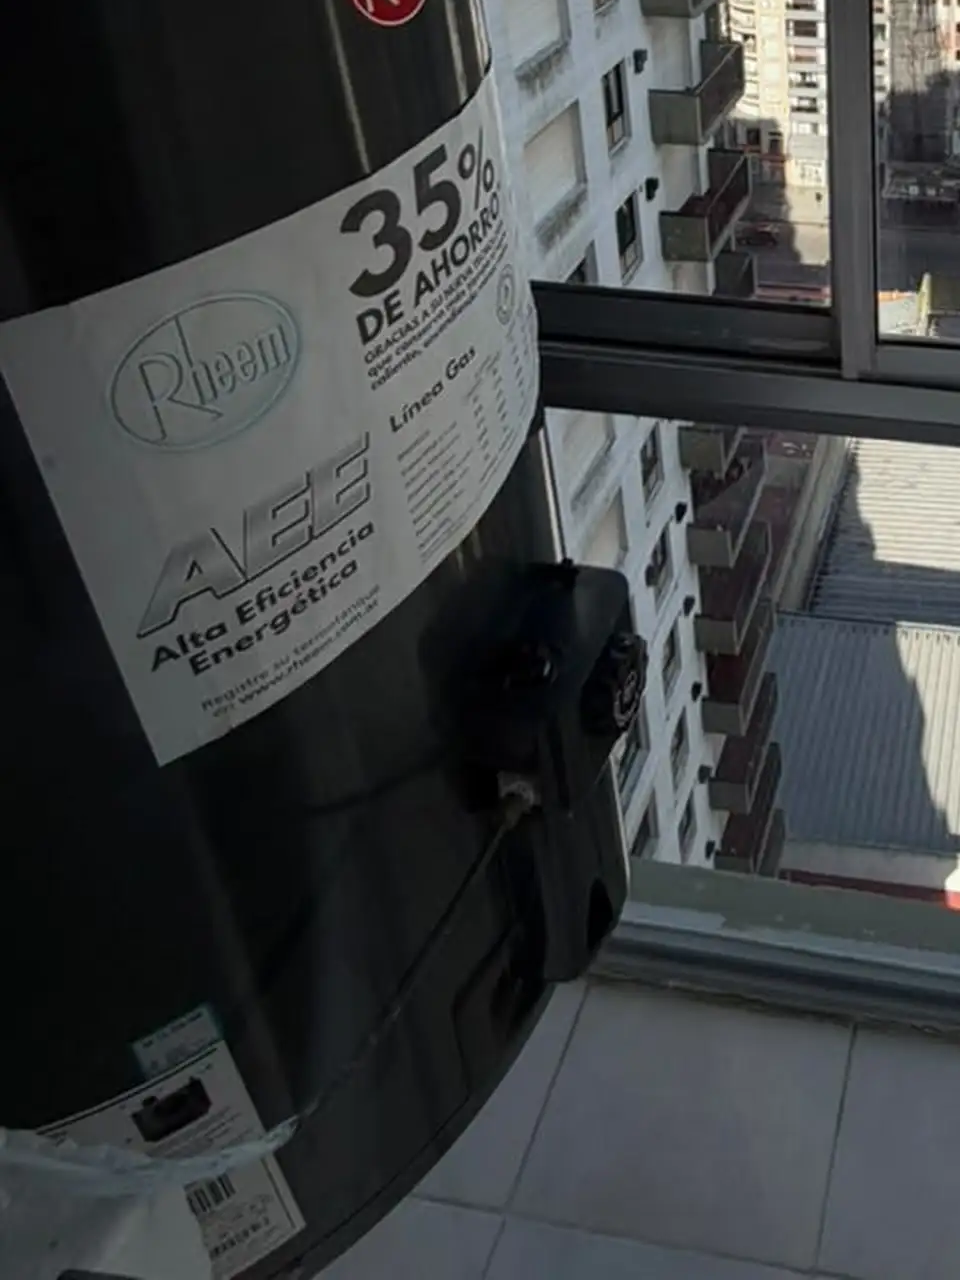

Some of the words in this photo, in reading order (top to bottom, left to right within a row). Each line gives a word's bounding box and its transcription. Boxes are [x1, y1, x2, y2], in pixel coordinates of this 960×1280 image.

[340, 125, 495, 299] 35%
[356, 288, 404, 346] DE
[414, 192, 500, 309] AHORRO
[139, 315, 292, 442] Rheem
[364, 315, 420, 364] GRACIAS
[389, 380, 443, 433] Línea
[445, 346, 476, 381] Gas
[151, 621, 228, 672] Alta
[235, 521, 376, 626] Eficiencia
[188, 558, 359, 676] Energética
[201, 670, 269, 711] Registre
